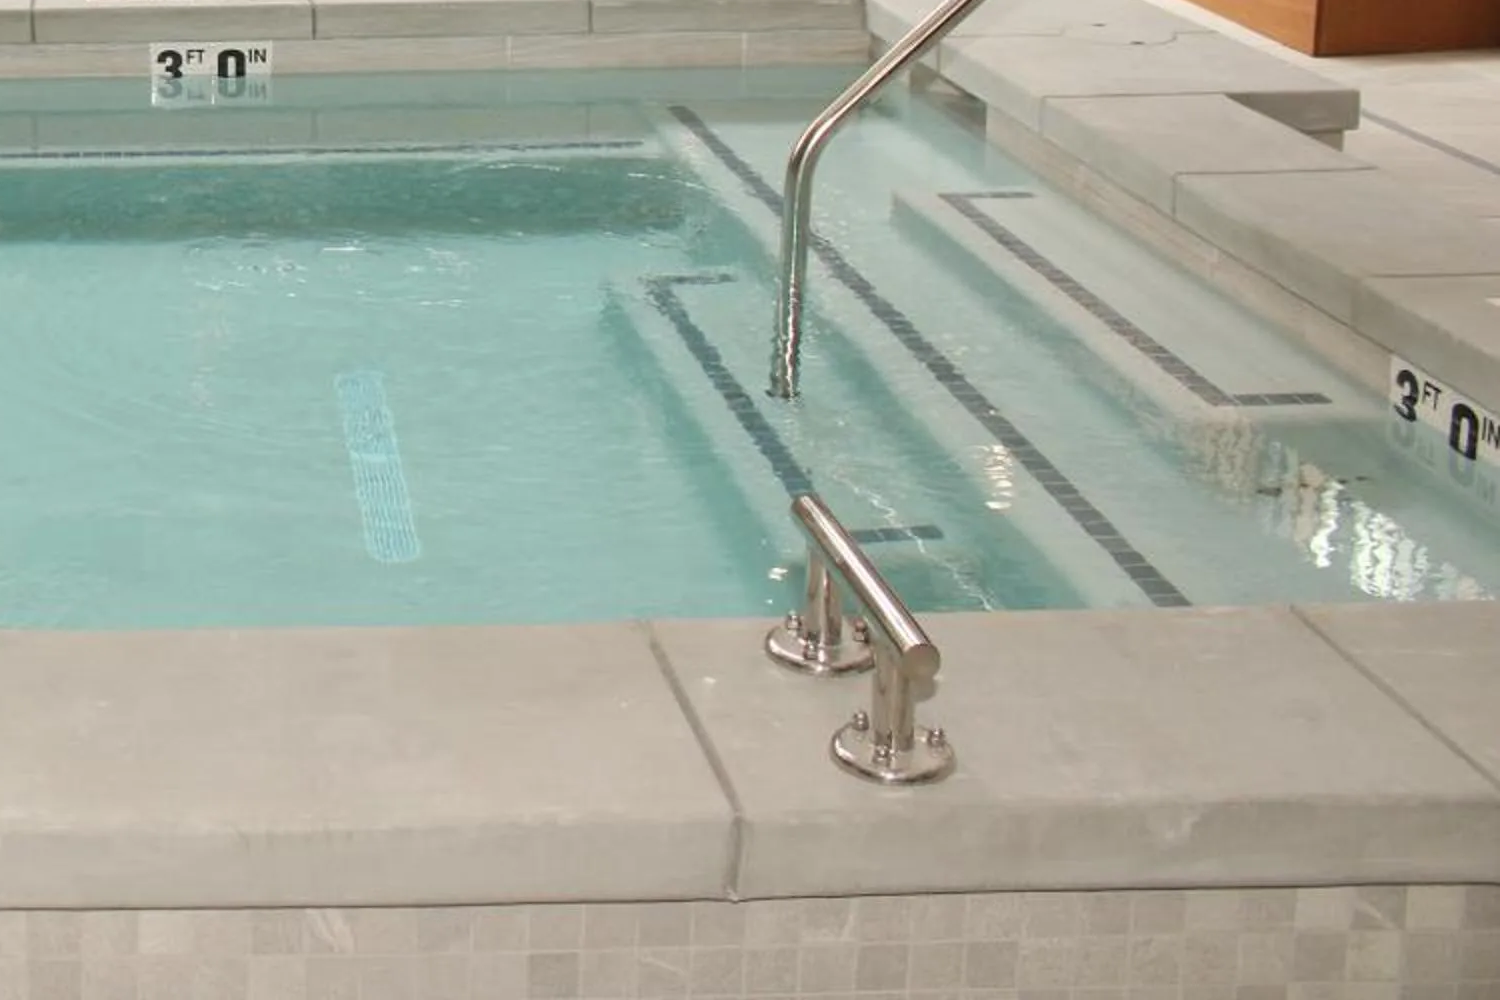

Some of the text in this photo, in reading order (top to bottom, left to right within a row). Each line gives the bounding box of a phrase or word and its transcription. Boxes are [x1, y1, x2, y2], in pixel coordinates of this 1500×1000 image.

[157, 48, 267, 78] 3 FT 0 IN
[1394, 369, 1500, 461] 3 FT 0 IN
